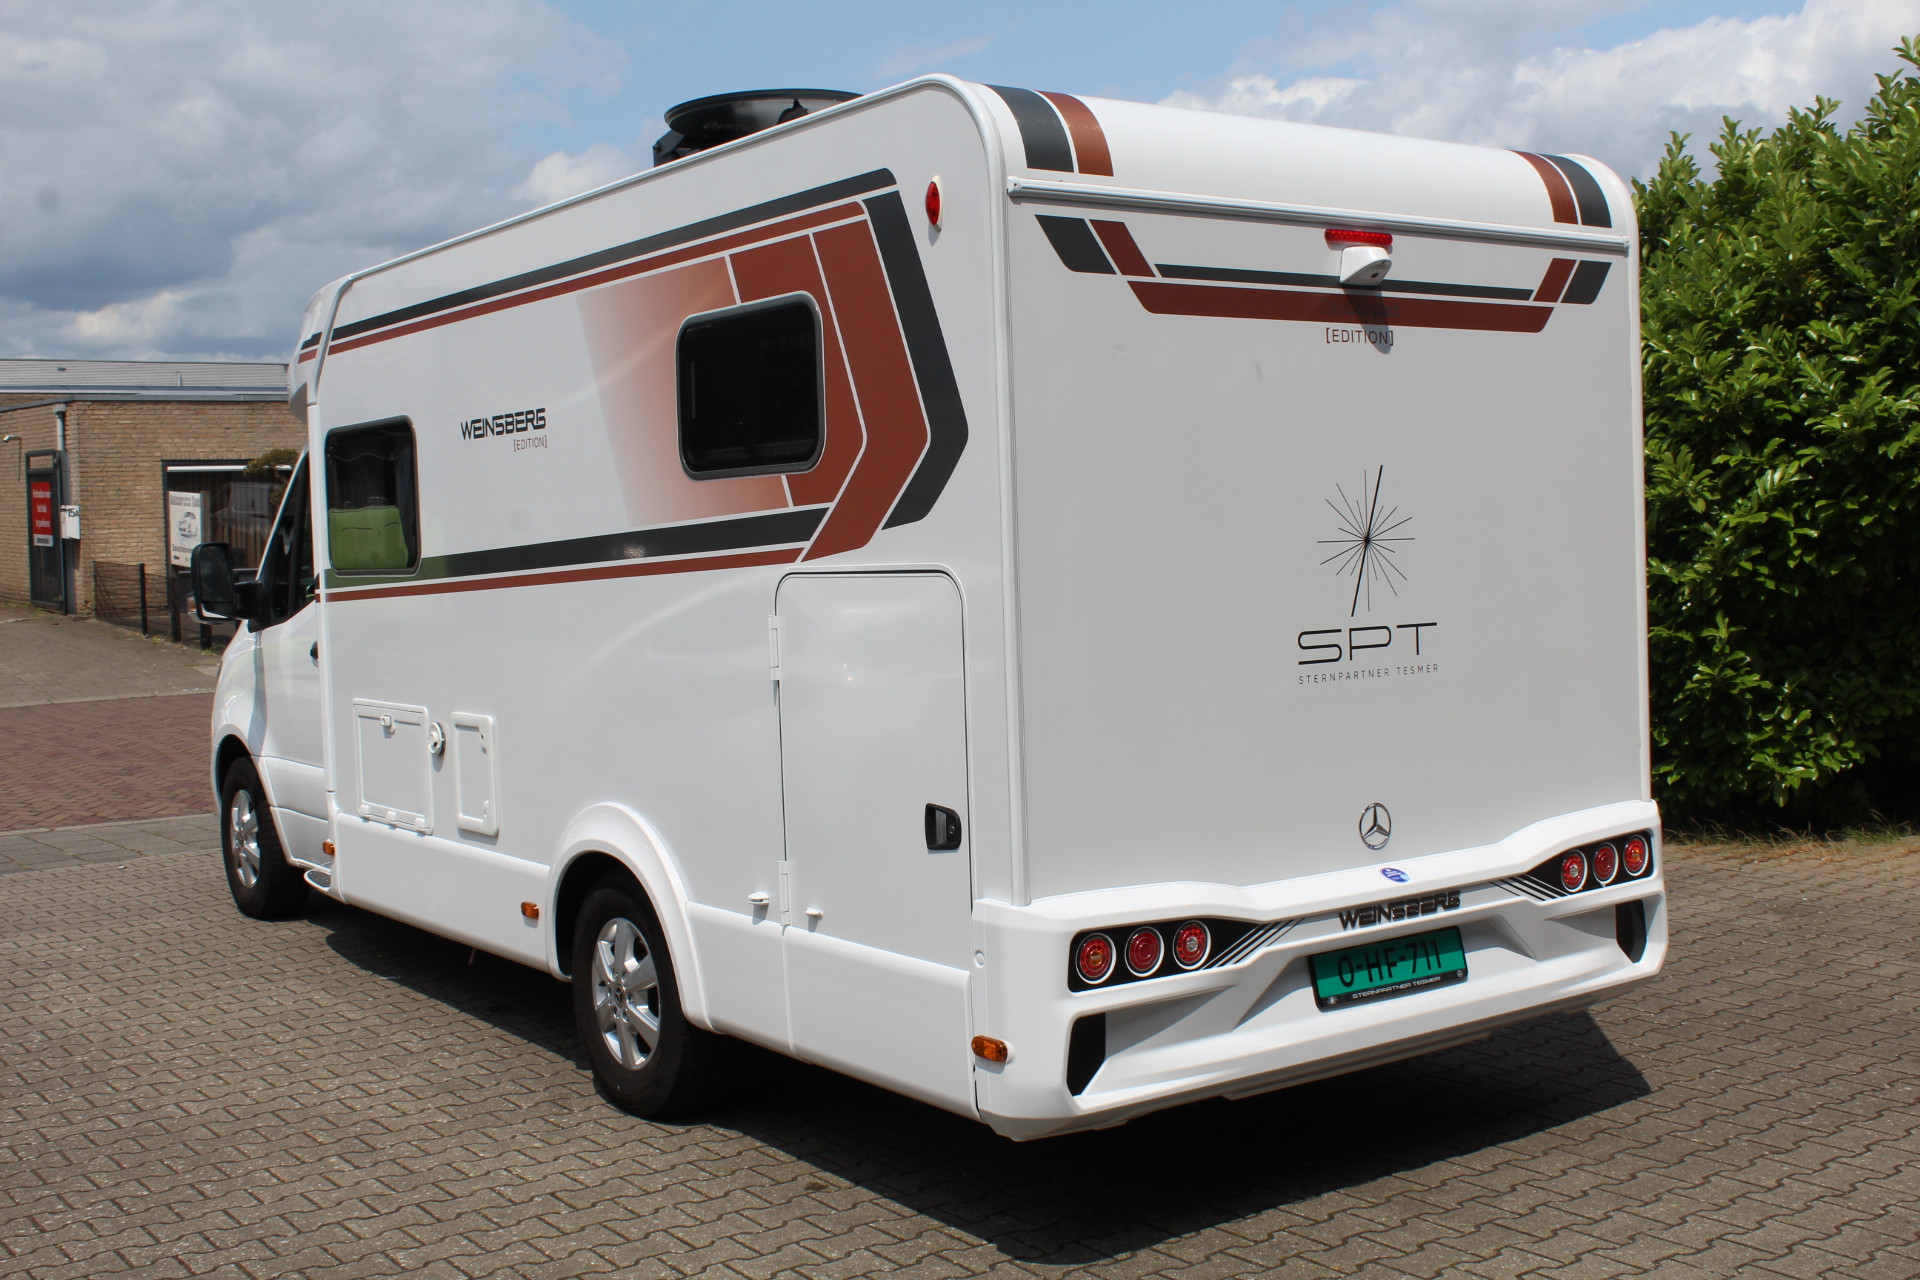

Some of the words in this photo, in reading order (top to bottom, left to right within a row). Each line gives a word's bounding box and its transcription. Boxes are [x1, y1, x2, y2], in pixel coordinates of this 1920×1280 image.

[460, 407, 546, 440] WEINSBERG
[1297, 622, 1438, 665] SPT
[1298, 667, 1390, 685] STERNPARTNER
[1396, 663, 1439, 676] TESMER
[1338, 890, 1461, 931] WEINSBERG
[1352, 982, 1412, 999] STERNPARTNER
[1413, 976, 1441, 988] TESMER
